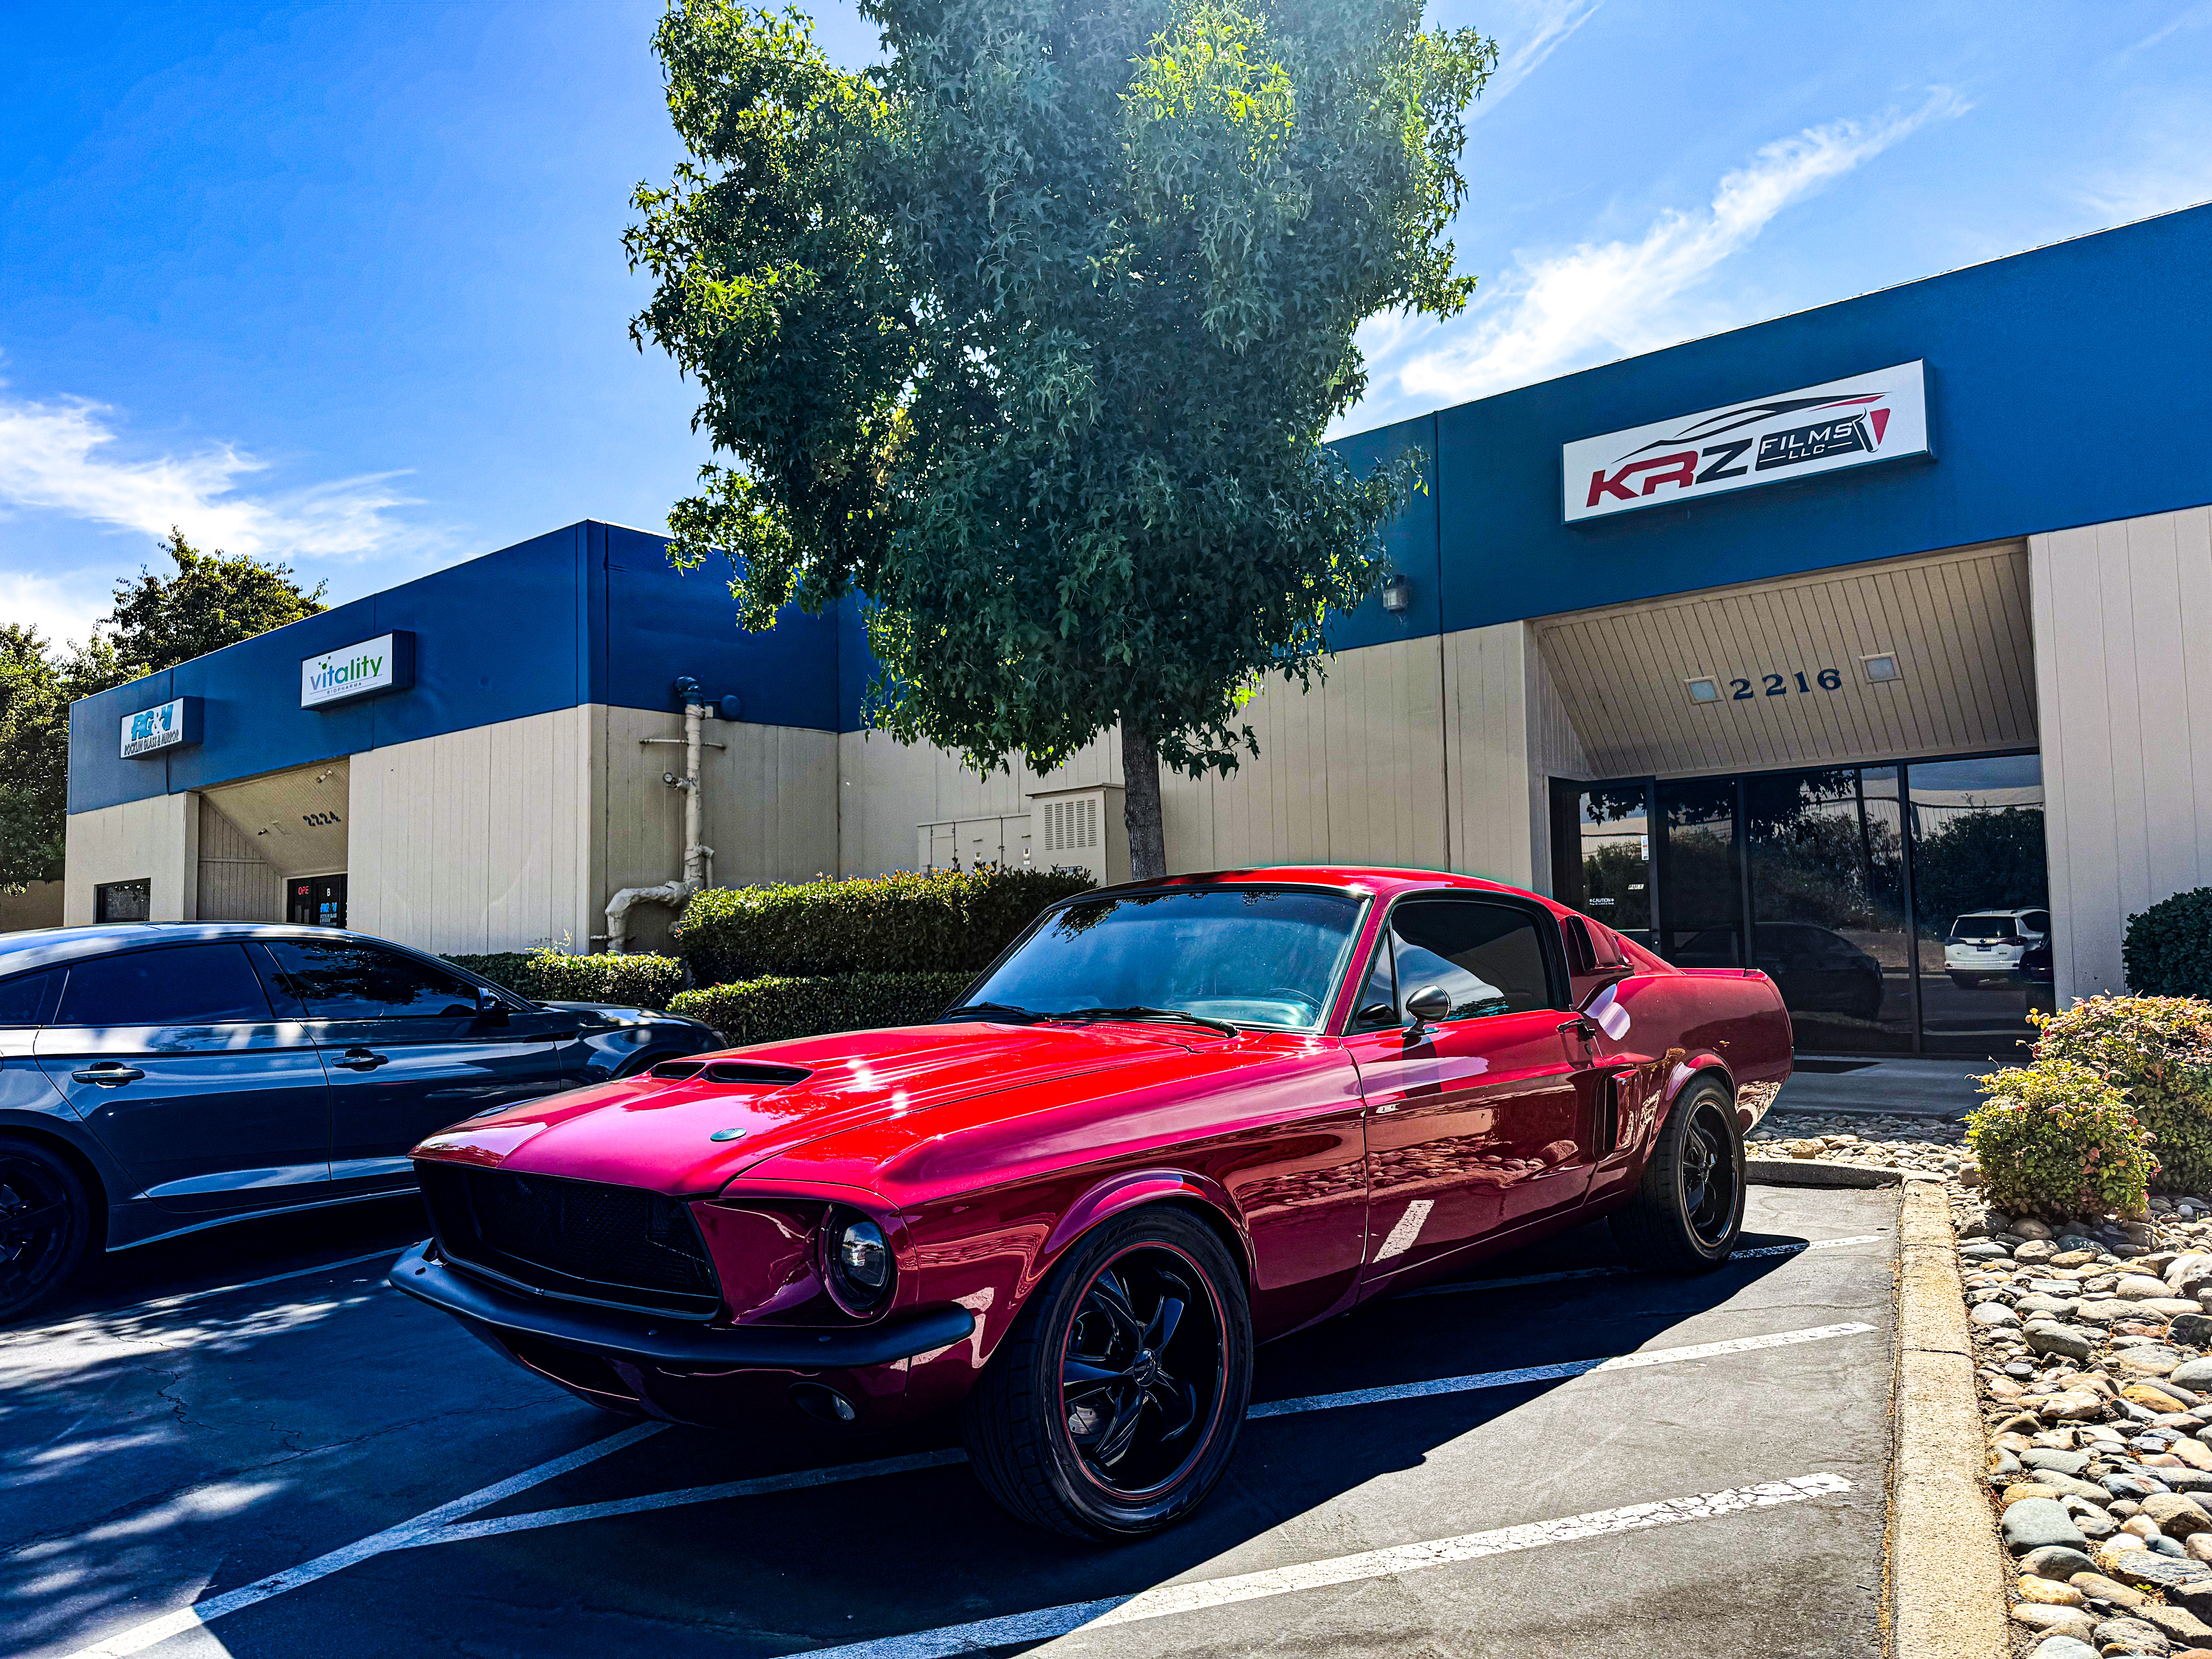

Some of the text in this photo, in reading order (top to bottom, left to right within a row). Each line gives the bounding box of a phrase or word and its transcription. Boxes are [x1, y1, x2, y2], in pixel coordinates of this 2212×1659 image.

[1789, 444, 1825, 459] LLC
[1586, 422, 1853, 507] KRZ FILMS
[310, 655, 383, 690] vitality
[327, 682, 362, 694] BIOPHARMA
[1729, 669, 1842, 700] 2216
[124, 739, 143, 756] ROCKLIN
[144, 735, 157, 750] GLASS
[161, 729, 179, 745] MIRROR
[303, 811, 341, 826] 2224
[327, 888, 330, 896] B
